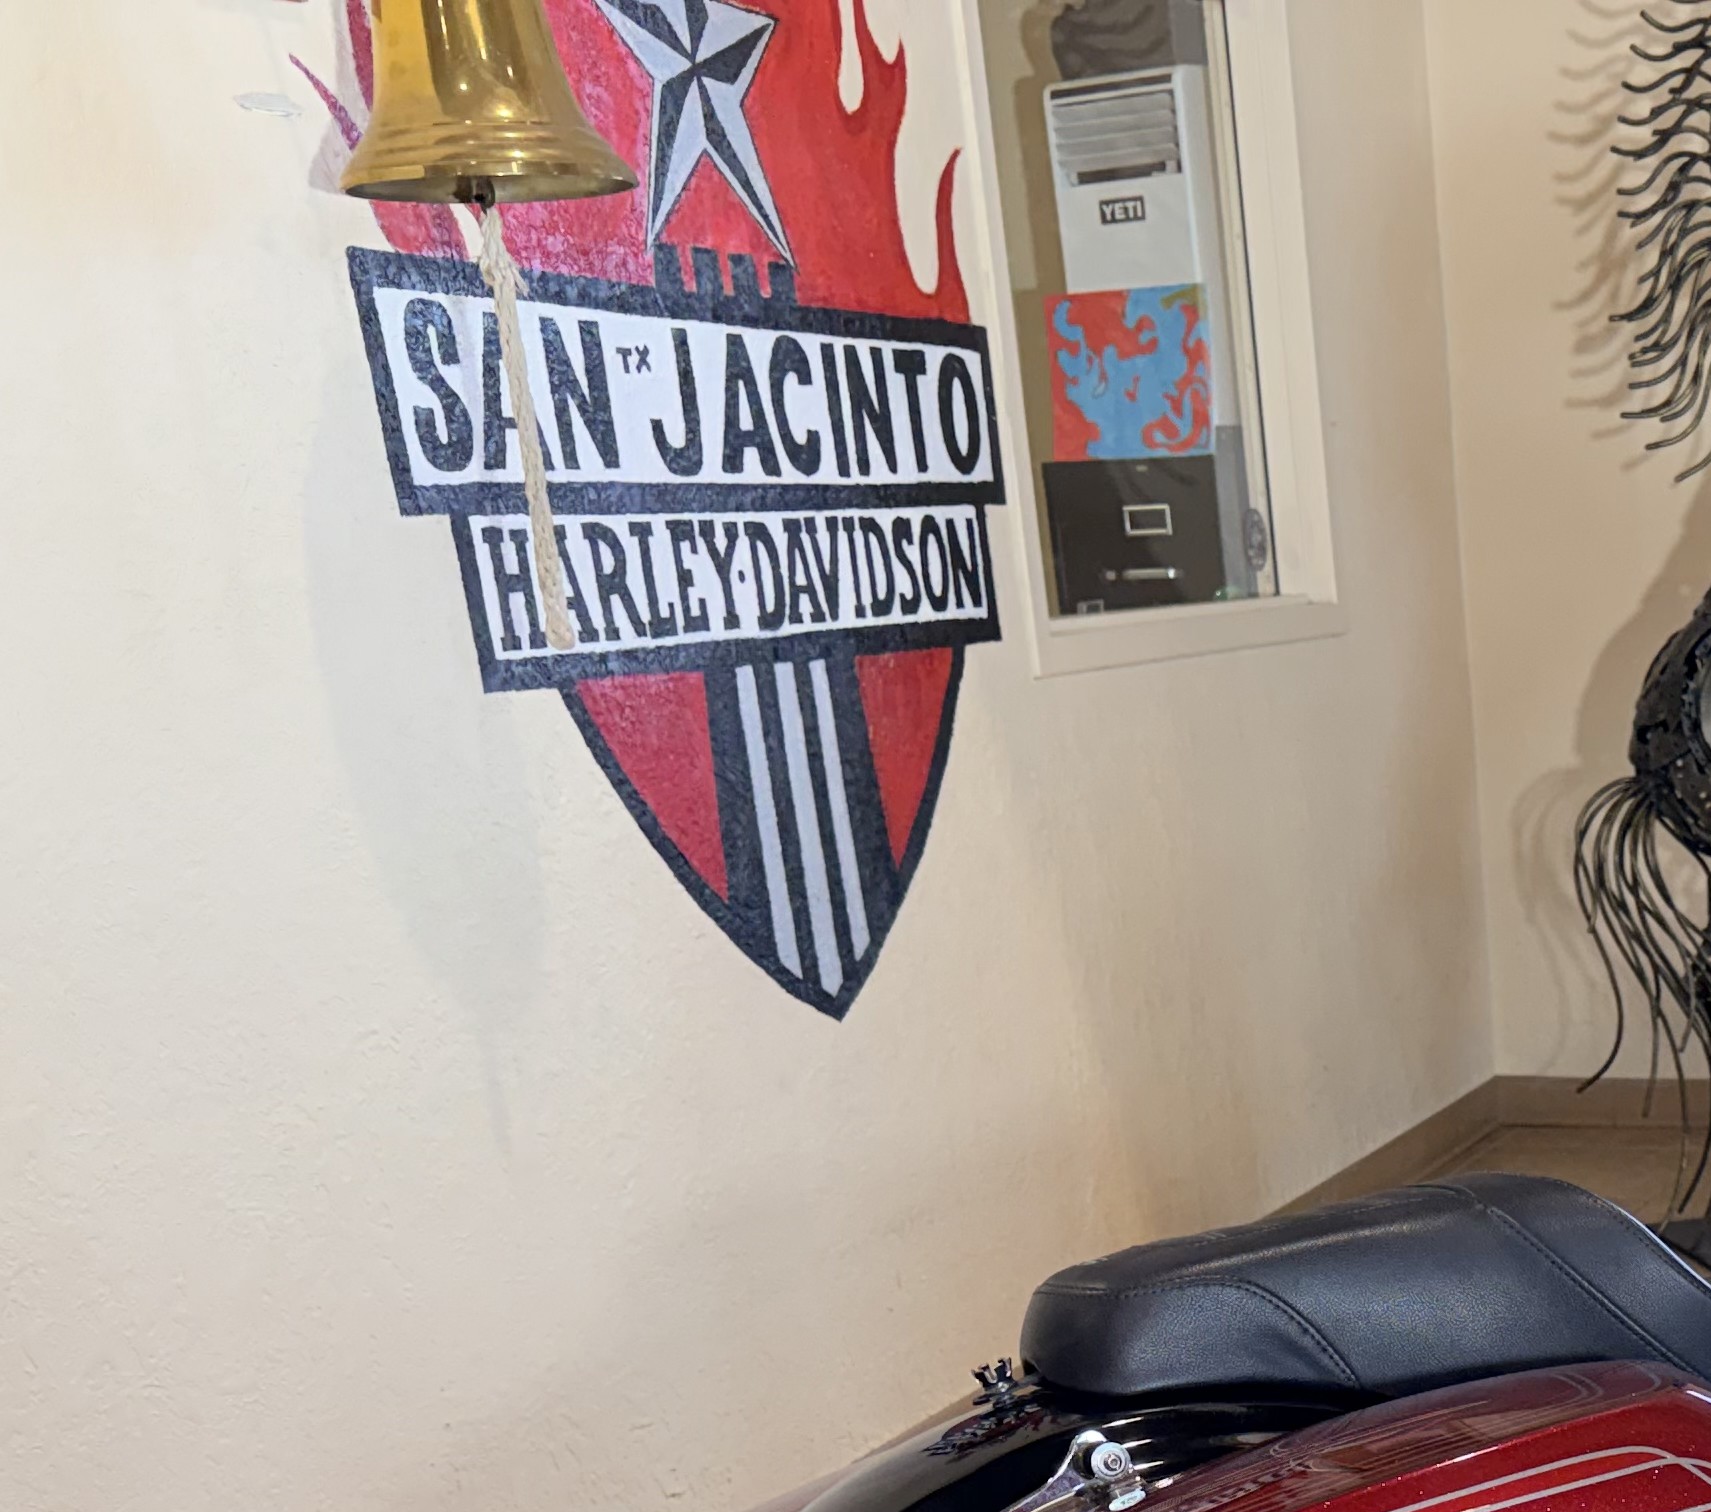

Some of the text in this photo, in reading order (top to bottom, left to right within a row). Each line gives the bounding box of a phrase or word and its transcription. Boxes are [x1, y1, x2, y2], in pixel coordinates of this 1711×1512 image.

[1100, 200, 1143, 222] YETI
[403, 297, 621, 473] SAN
[649, 327, 982, 478] JACINTO
